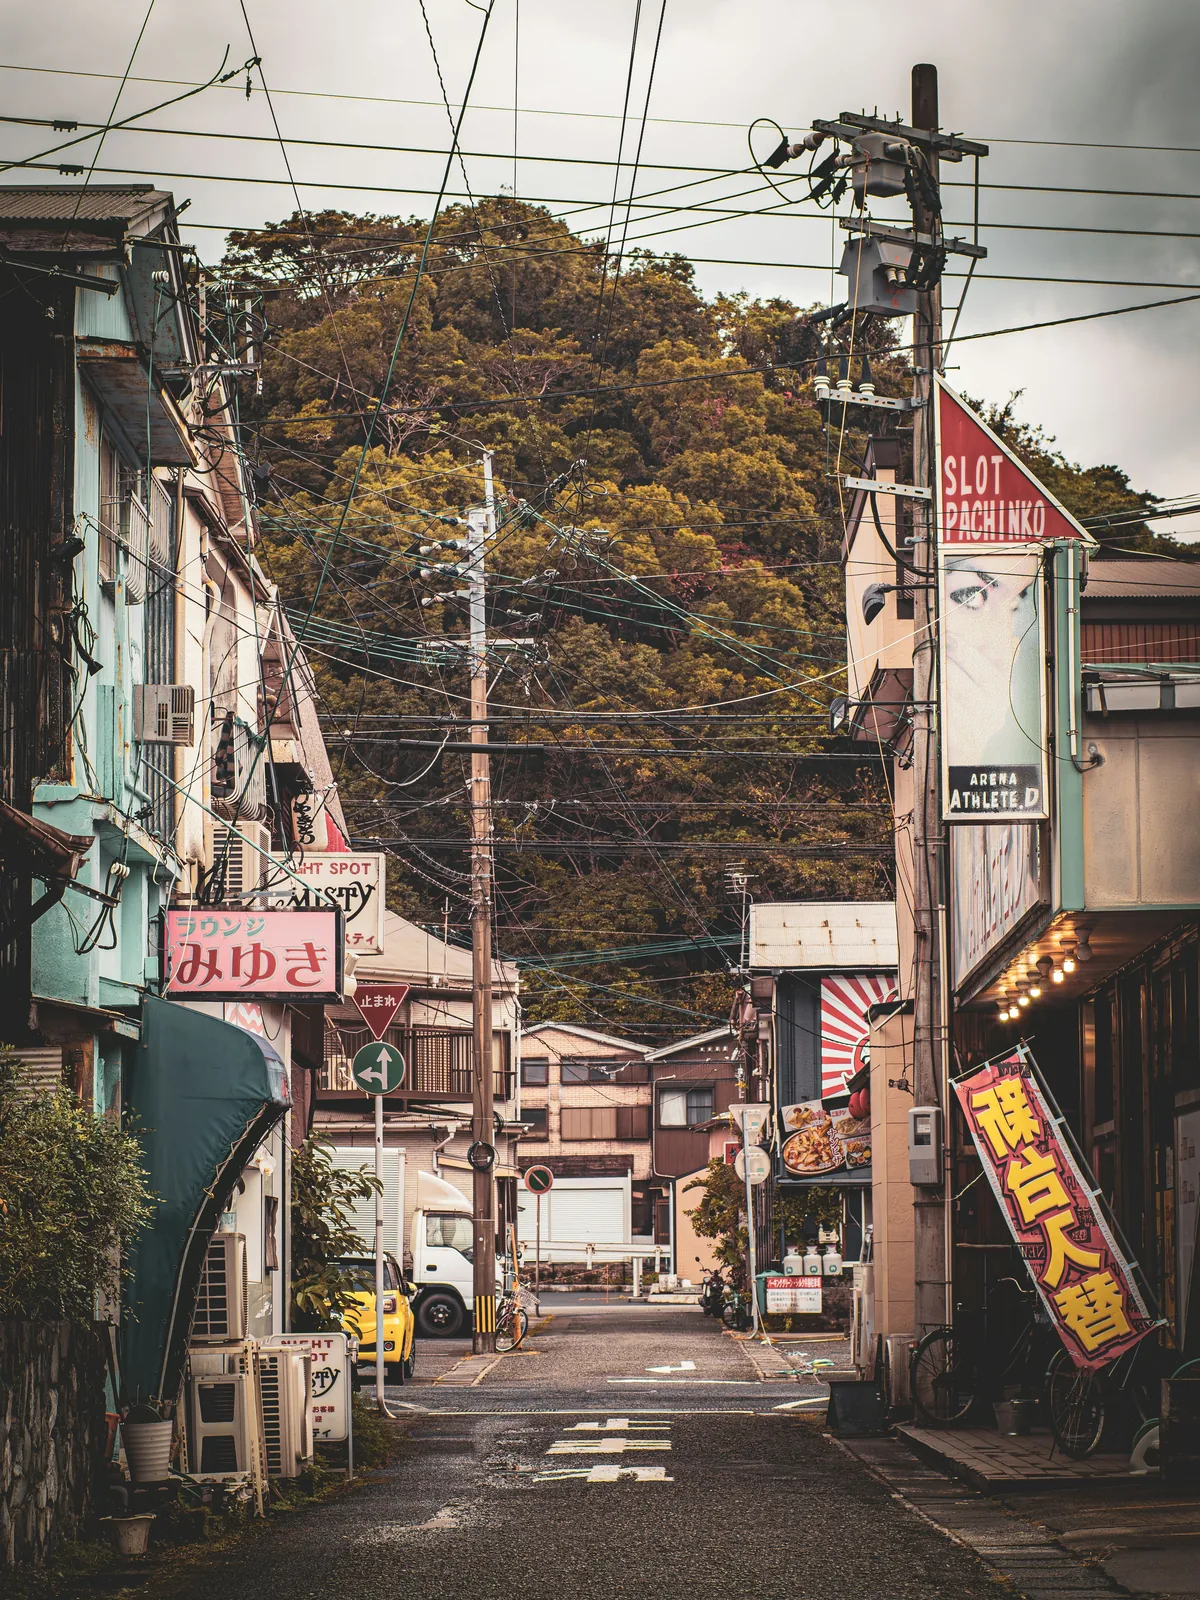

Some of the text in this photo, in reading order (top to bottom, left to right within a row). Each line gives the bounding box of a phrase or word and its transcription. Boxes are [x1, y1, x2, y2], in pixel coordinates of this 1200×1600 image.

[944, 454, 1004, 496] SLOT
[945, 500, 1046, 541] PACHINKO
[970, 773, 1017, 786] ARENA
[330, 862, 372, 875] SPOT
[176, 916, 266, 937] ラウンジ
[176, 940, 329, 988] みゆき
[360, 994, 398, 1007] 止まれ
